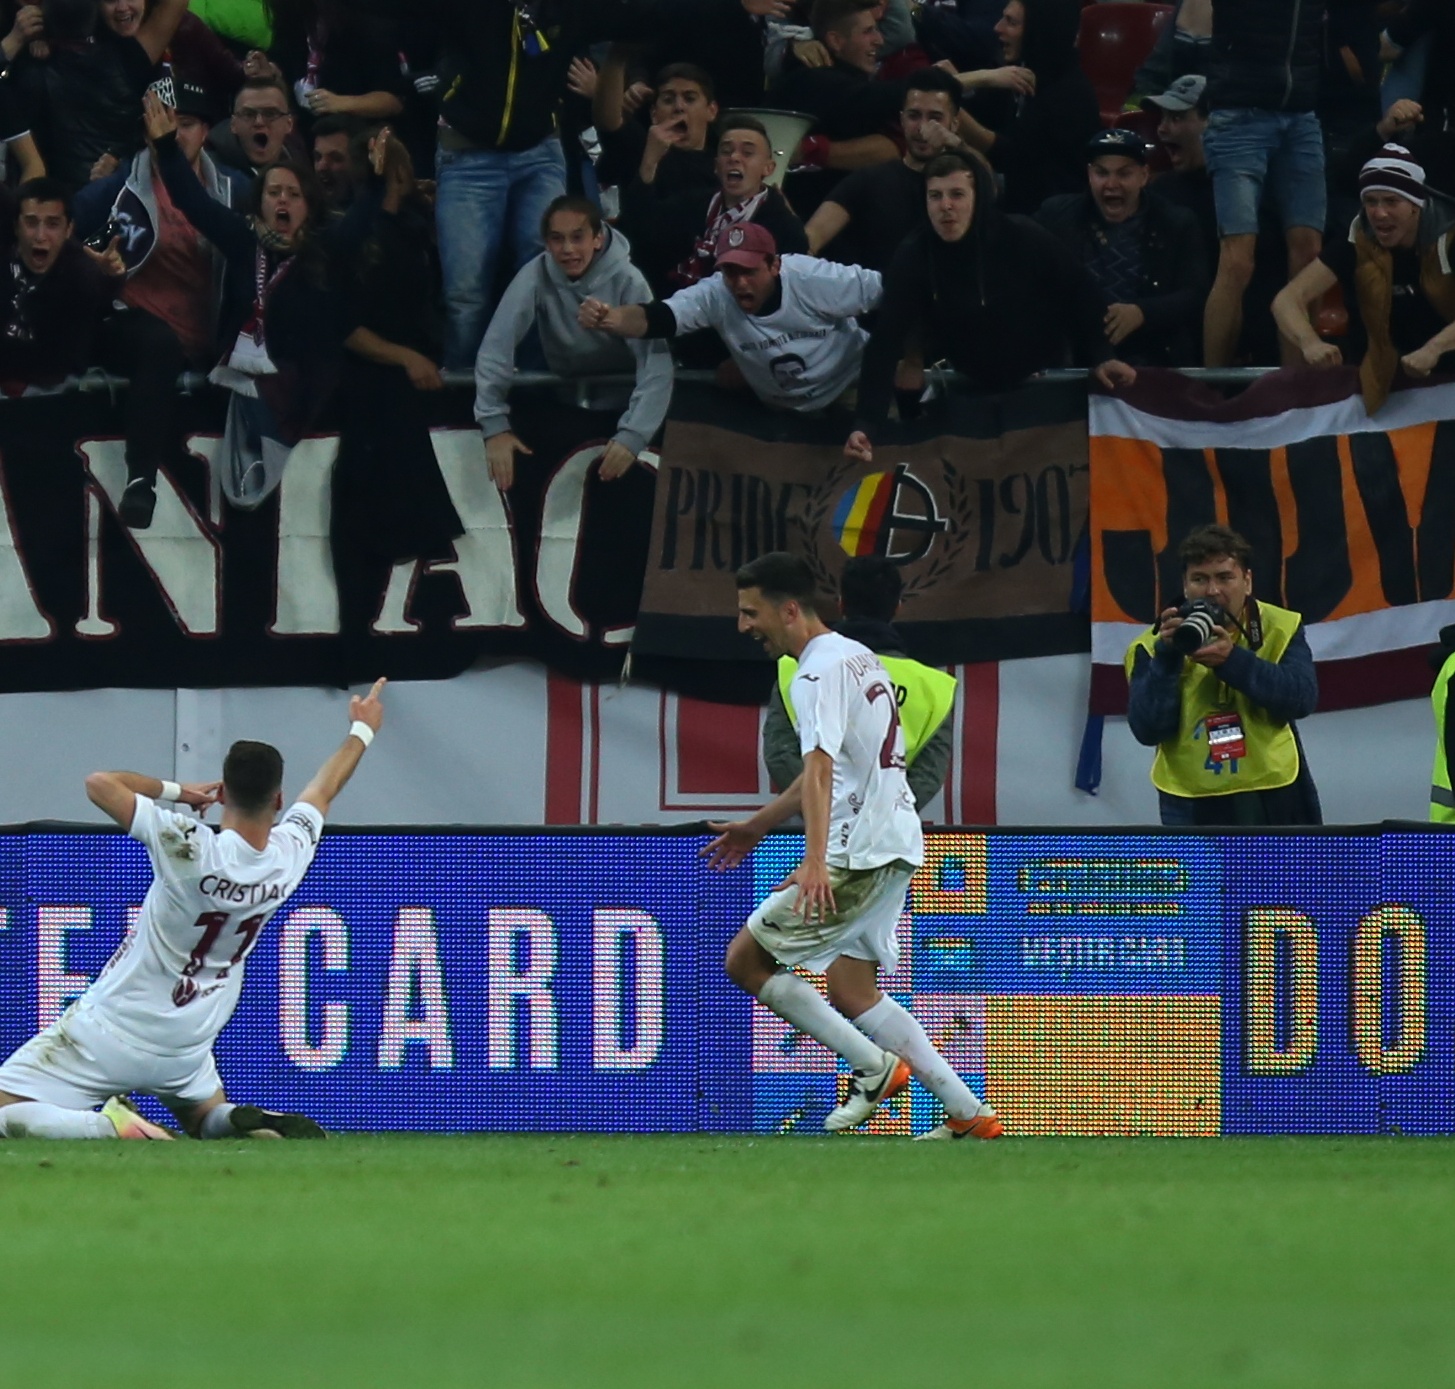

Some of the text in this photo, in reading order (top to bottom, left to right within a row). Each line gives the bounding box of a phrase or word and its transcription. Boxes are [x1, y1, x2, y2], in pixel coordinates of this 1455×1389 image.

[659, 466, 811, 572] PRIDE
[184, 912, 264, 979] 11
[278, 906, 666, 1073] CARD
